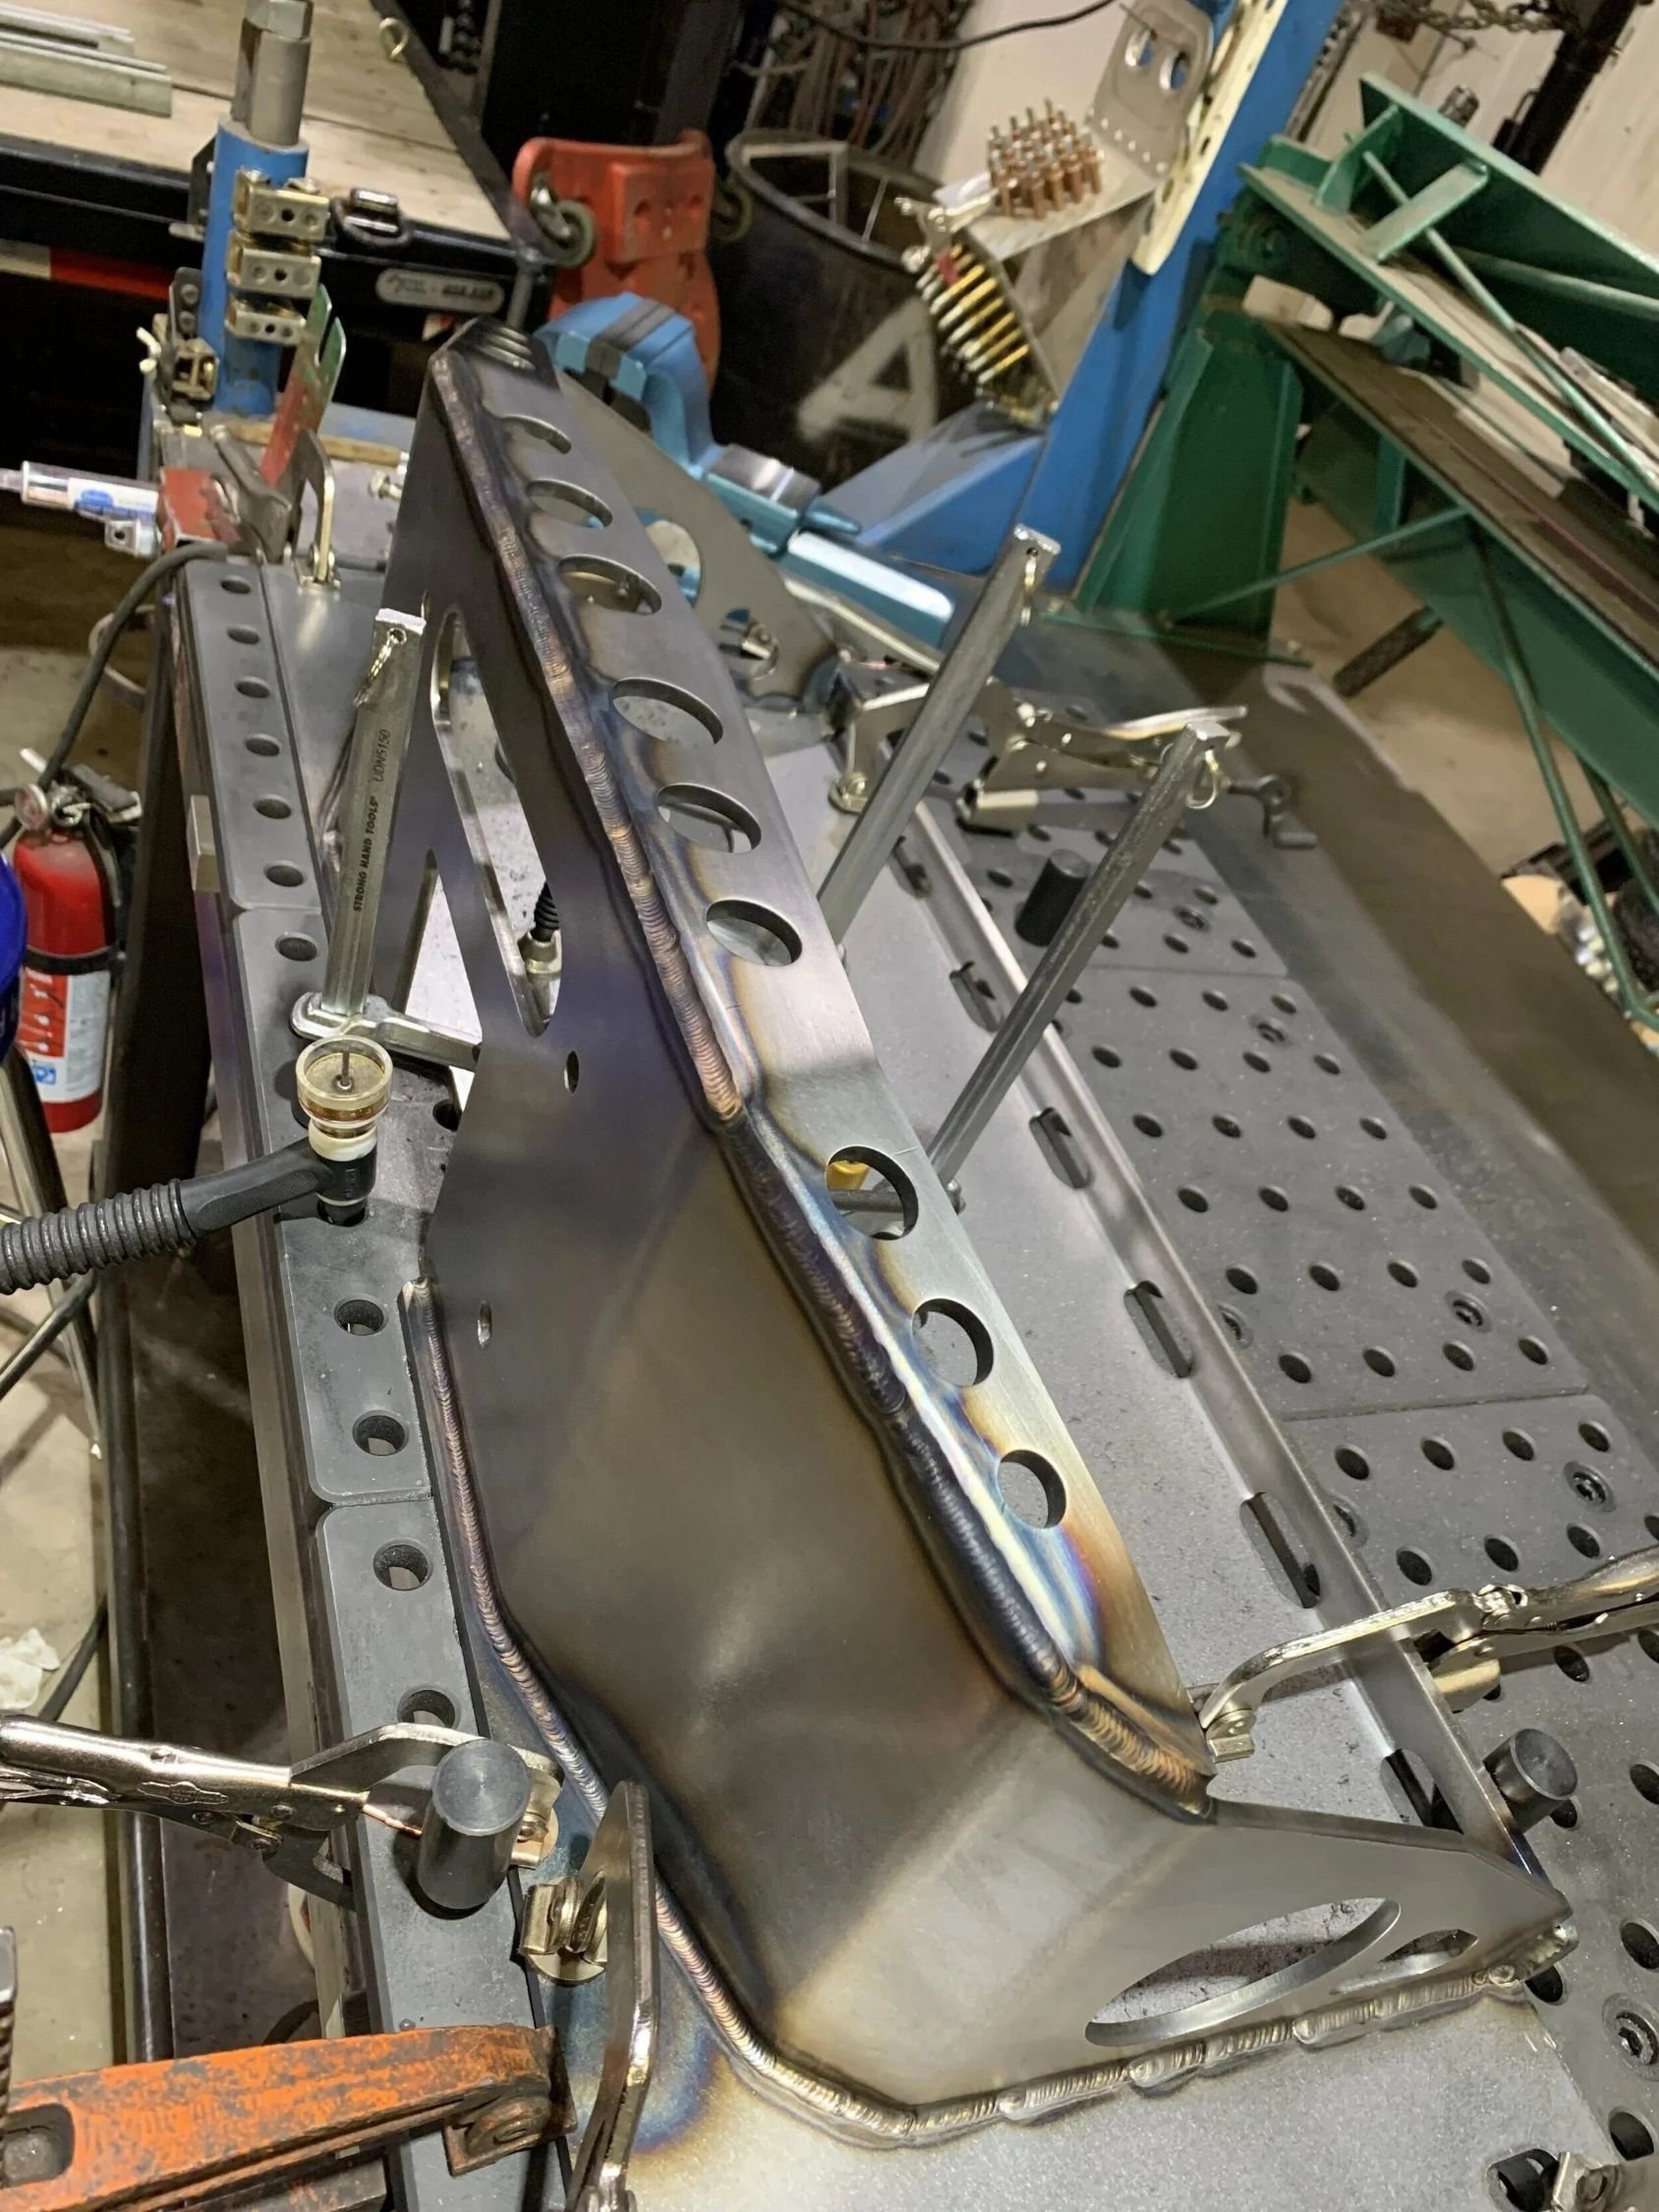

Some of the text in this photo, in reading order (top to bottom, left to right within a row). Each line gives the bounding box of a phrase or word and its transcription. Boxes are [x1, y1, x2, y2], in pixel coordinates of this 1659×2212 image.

[372, 728, 391, 783] UDN5150
[360, 838, 372, 869] HAND
[353, 870, 368, 912] STRONG
